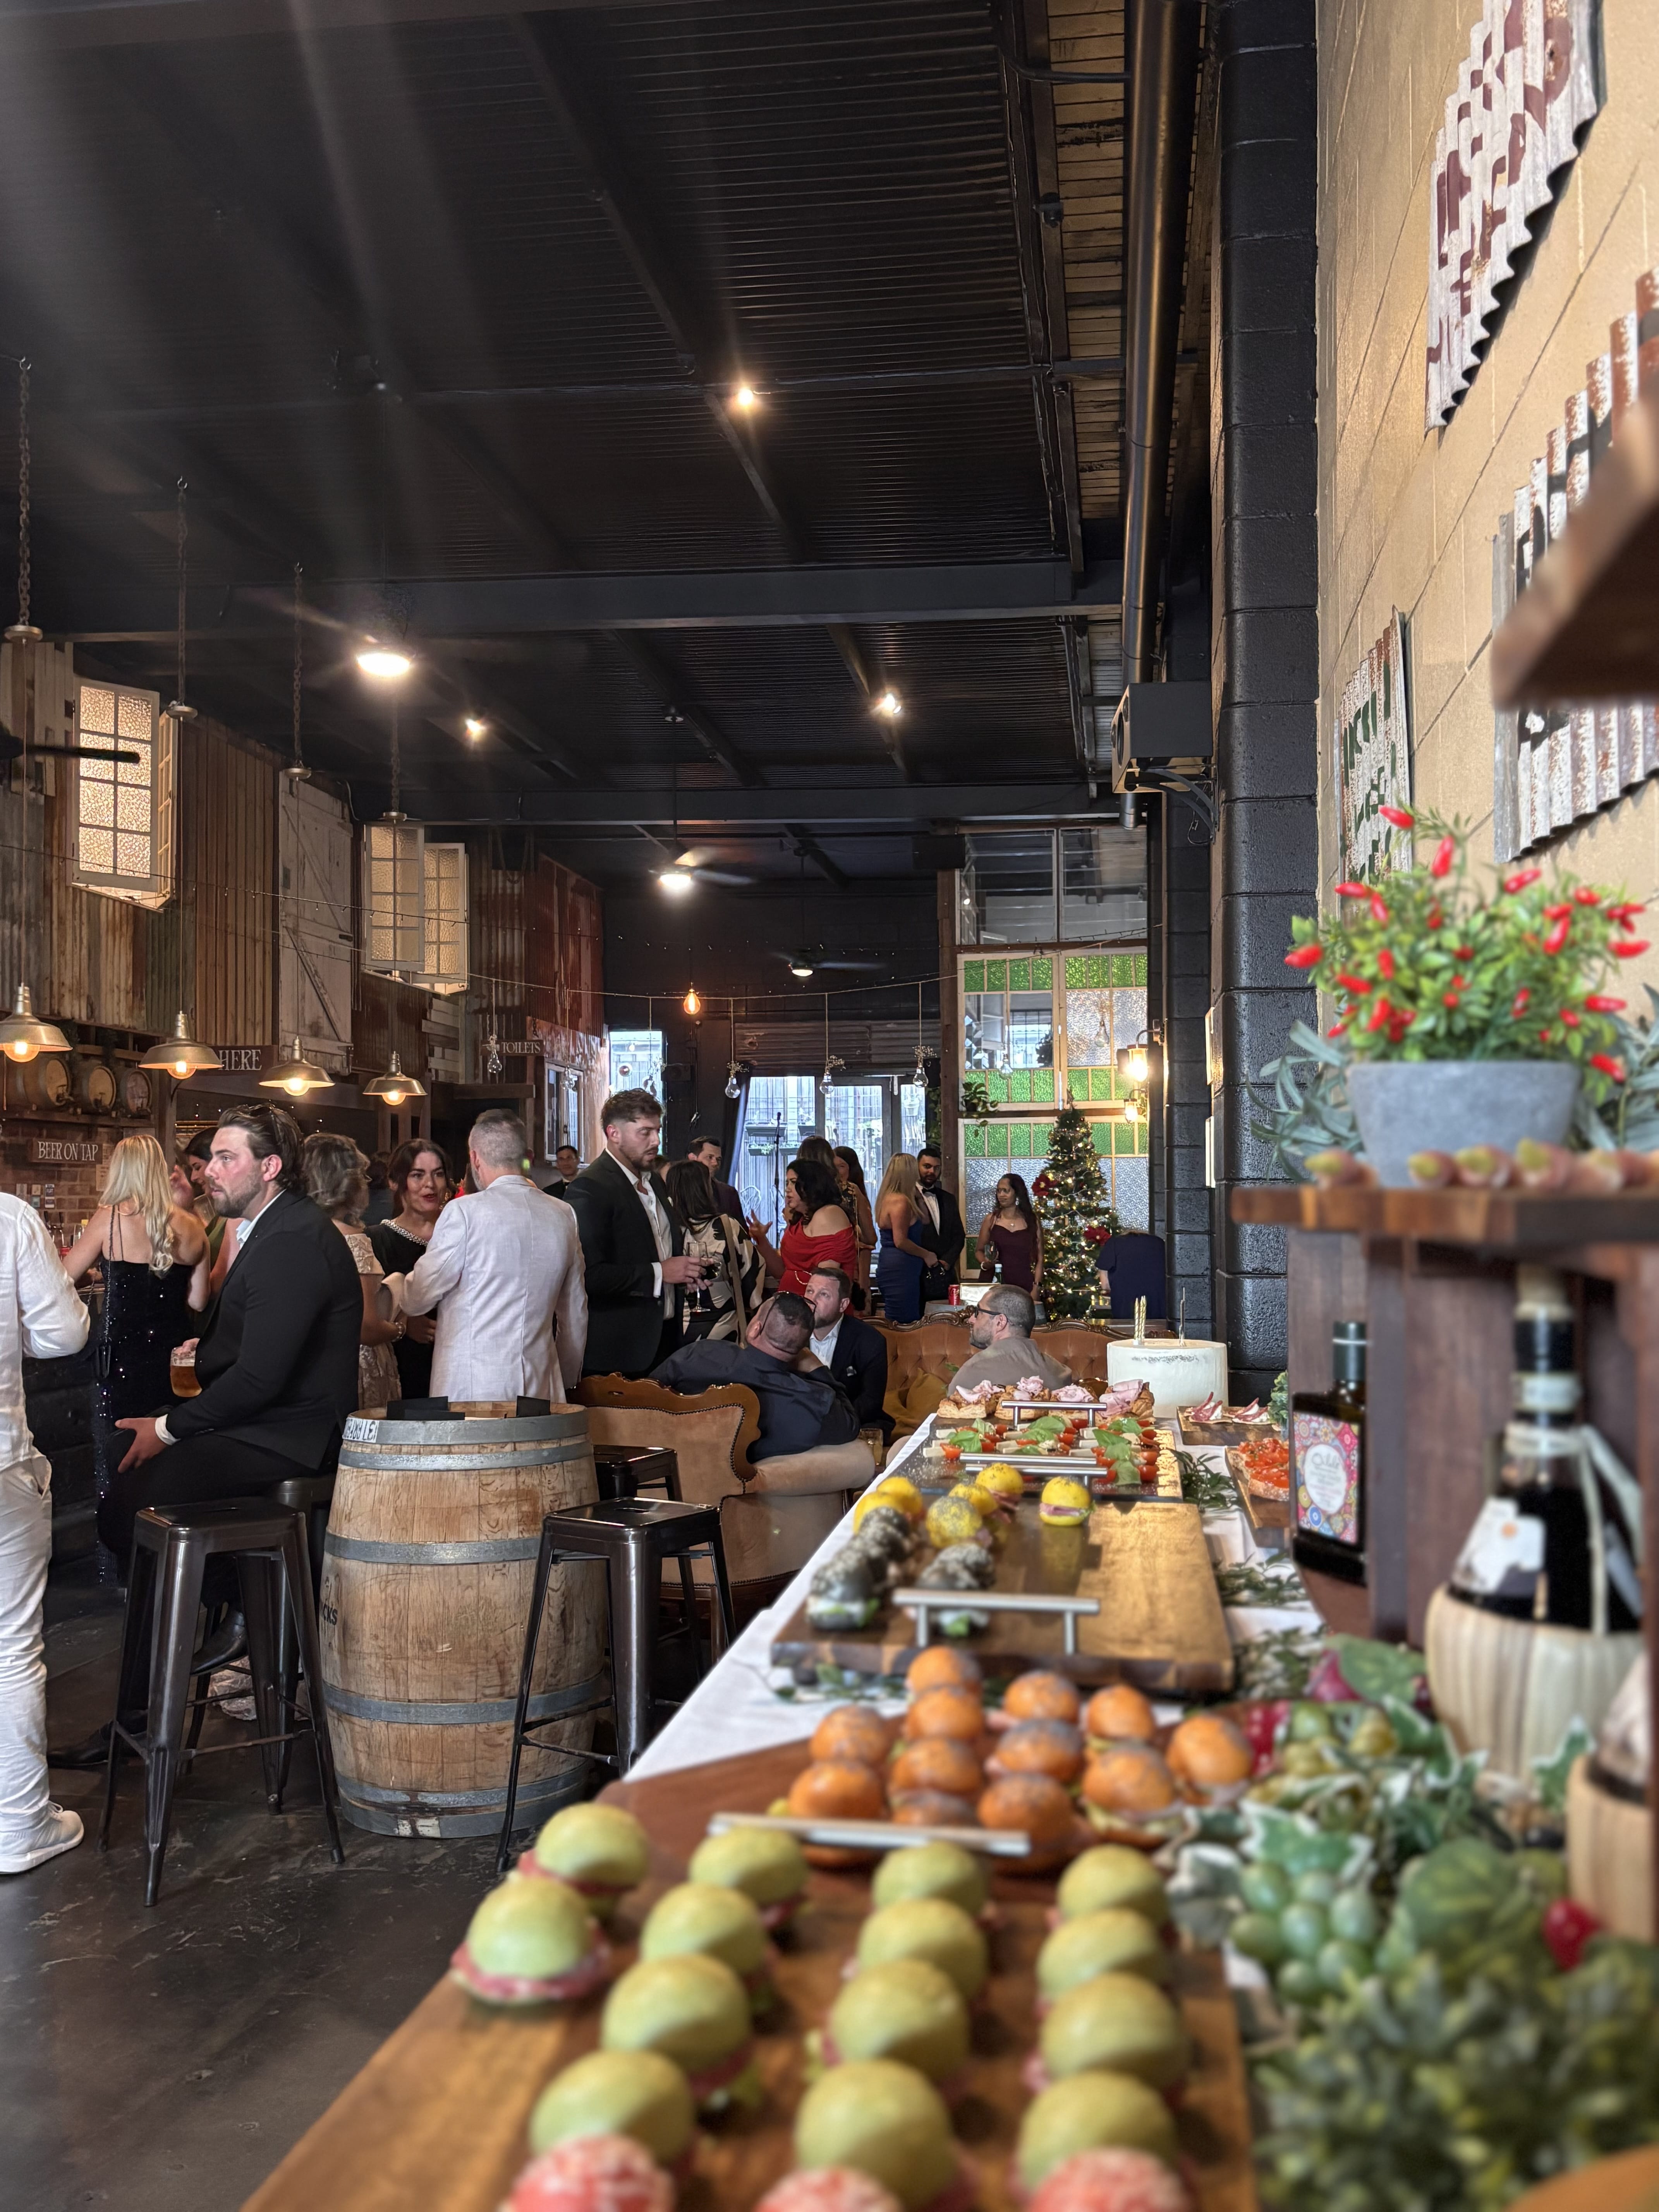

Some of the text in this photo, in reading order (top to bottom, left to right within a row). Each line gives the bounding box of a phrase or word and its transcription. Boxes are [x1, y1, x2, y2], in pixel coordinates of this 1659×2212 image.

[501, 1042, 541, 1053] TOILETS
[218, 1049, 262, 1071] HERE
[38, 1141, 98, 1161] BEER ON TAP
